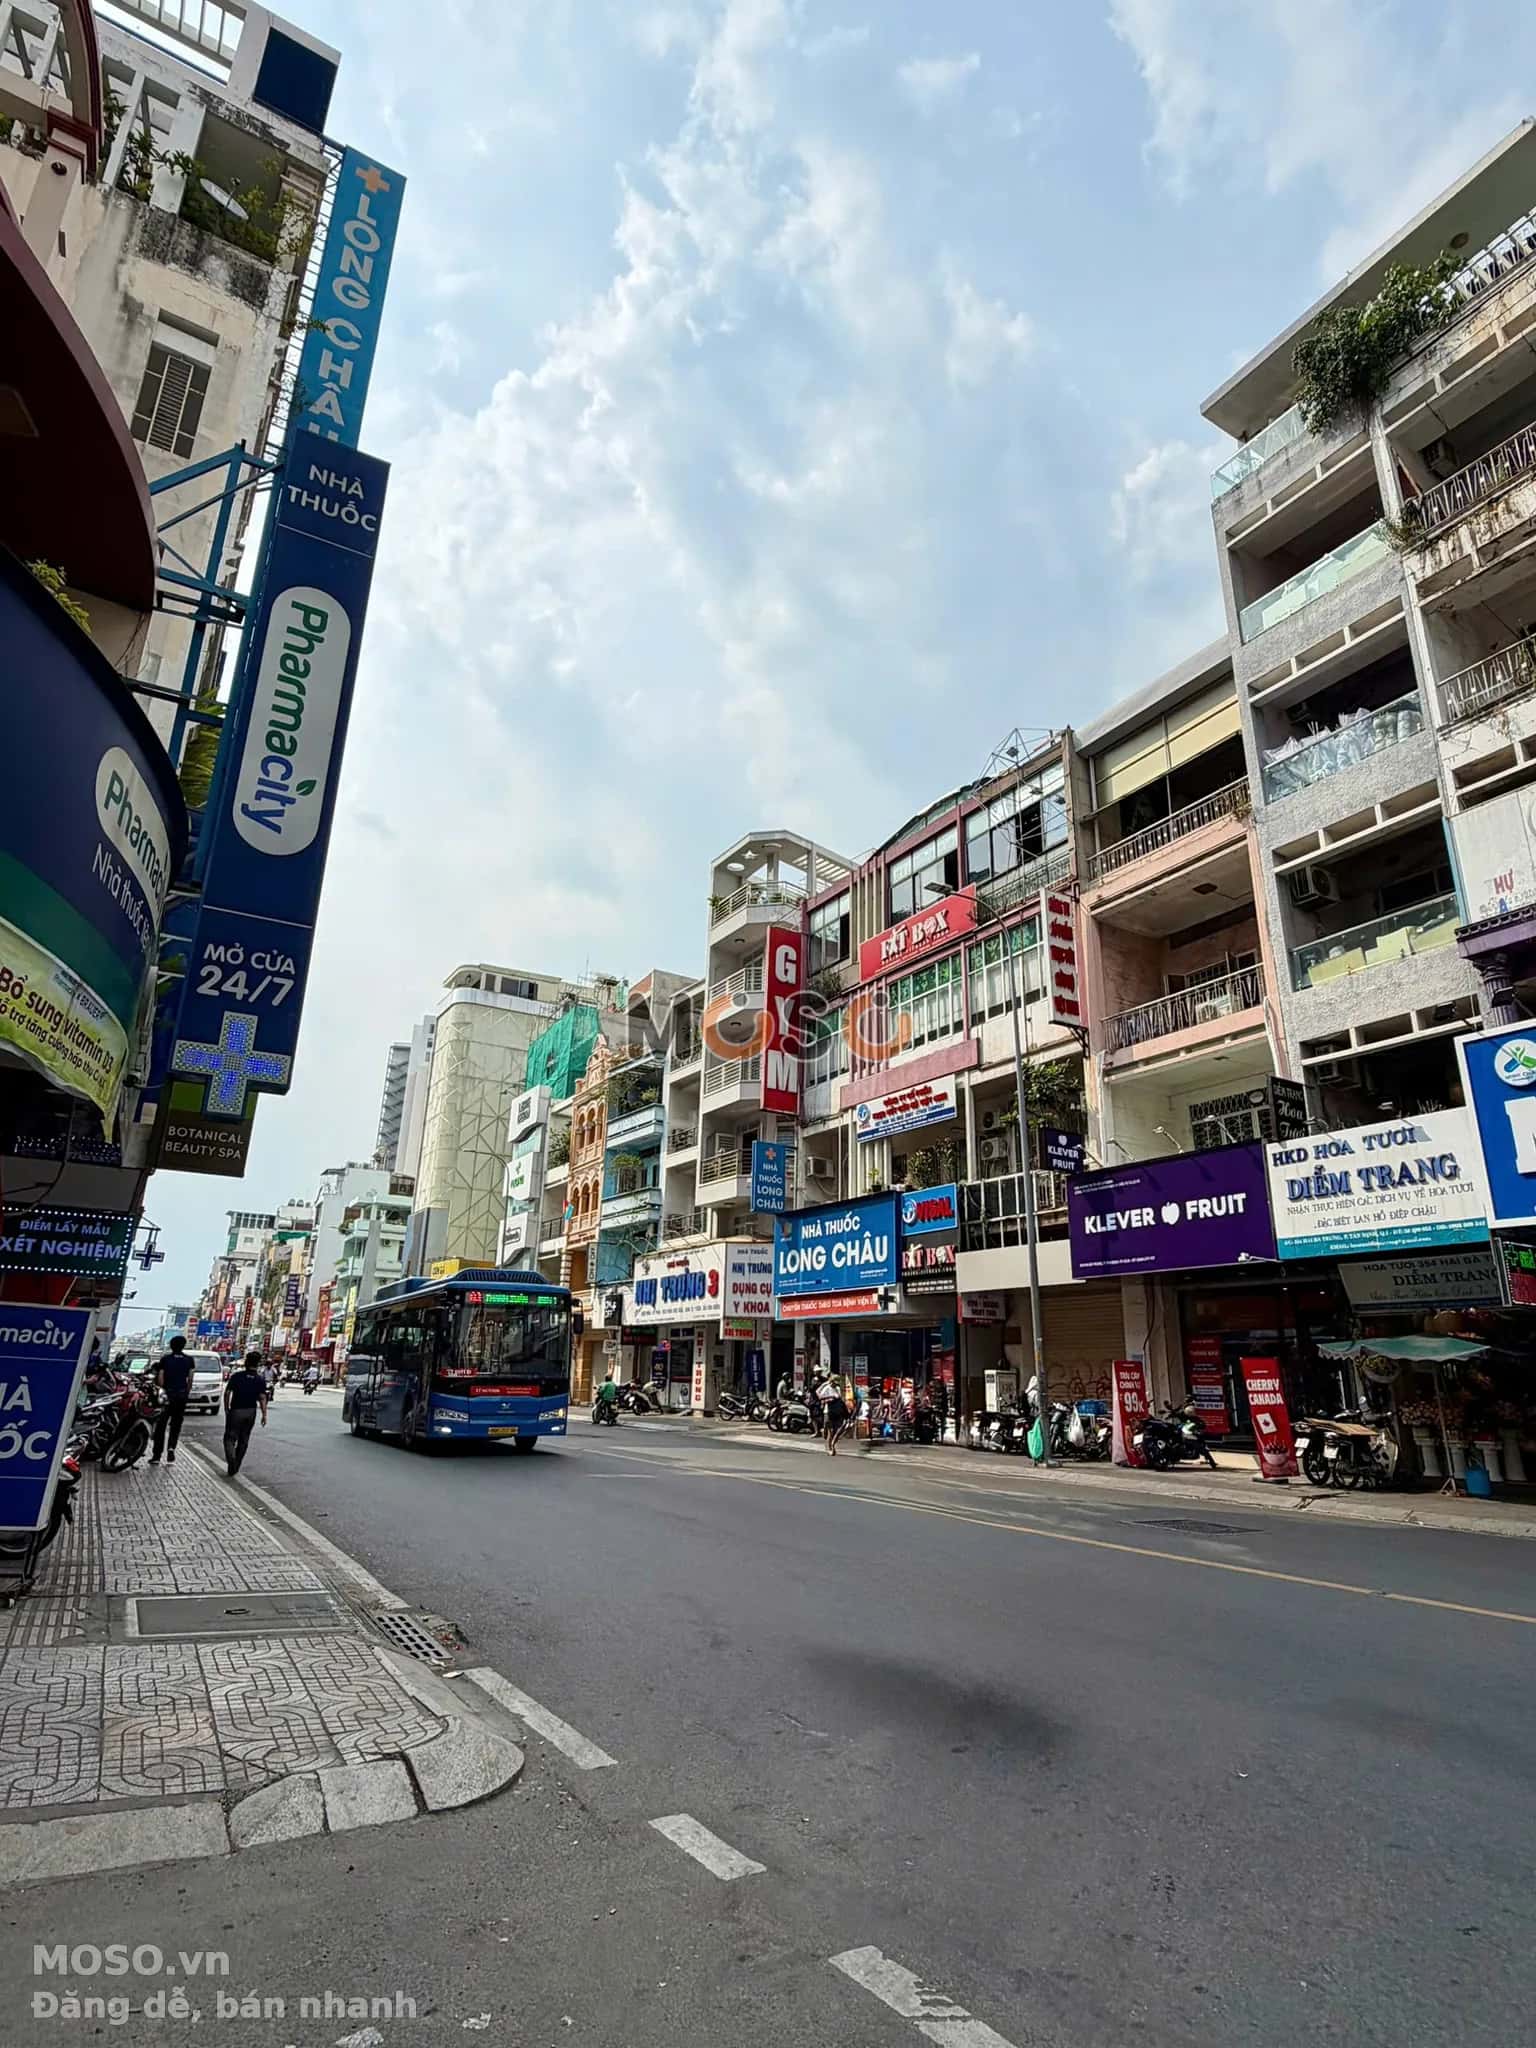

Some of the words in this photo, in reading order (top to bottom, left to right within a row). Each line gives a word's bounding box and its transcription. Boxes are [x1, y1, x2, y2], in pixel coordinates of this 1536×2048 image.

[332, 193, 381, 310] LONG
[308, 464, 364, 499] NHÀ
[287, 485, 377, 532] THUỐC
[240, 600, 329, 834] Pharmacity
[103, 769, 168, 912] Pharmac
[92, 842, 122, 900] Nhà
[203, 943, 244, 965] MỞ
[250, 951, 296, 975] CỬA
[196, 966, 295, 1007] 24/7
[0, 966, 28, 1000] Bổ
[26, 991, 64, 1033] sung
[63, 1018, 103, 1063] vitamin
[766, 943, 799, 1094] GYM
[167, 1126, 244, 1145] BOTANICAL
[1272, 1148, 1308, 1167] HKD
[1314, 1139, 1354, 1159] HOA
[1362, 1126, 1417, 1151] TƯƠI
[164, 1141, 215, 1156] BEAUTY
[217, 1144, 242, 1160] SPA
[1047, 1145, 1079, 1159] KLEVER
[1052, 1157, 1075, 1170] FRUIT
[757, 1185, 783, 1197] LONG
[759, 1174, 783, 1184] THUỐC
[1286, 1164, 1353, 1202] DIỄM
[1357, 1152, 1461, 1193] TRANG
[756, 1198, 784, 1210] CHÂU
[1085, 1207, 1155, 1234] KLEVER
[1185, 1192, 1247, 1221] FRUIT
[19, 1216, 52, 1232] ĐIỂM
[54, 1220, 78, 1233] LẤY
[801, 1219, 823, 1240] NHÀ
[824, 1211, 861, 1236] THUỐC
[0, 1234, 37, 1254] XÉT
[40, 1239, 122, 1262] NGHIỆM
[779, 1245, 827, 1275] LONG
[831, 1231, 889, 1269] CHÂU
[925, 1245, 955, 1266] BOX
[732, 1262, 745, 1276] NHỊ
[1363, 1265, 1387, 1273] HOA
[1392, 1267, 1438, 1286] DIỄM
[635, 1279, 658, 1311] NHỊ
[707, 1268, 720, 1297] 3
[732, 1282, 757, 1299] DỤNG
[759, 1282, 772, 1297] CỤ
[733, 1302, 740, 1313] Y
[743, 1301, 770, 1313] KHOA
[1246, 1378, 1280, 1391] CHERRY
[1248, 1393, 1284, 1406] CANADA
